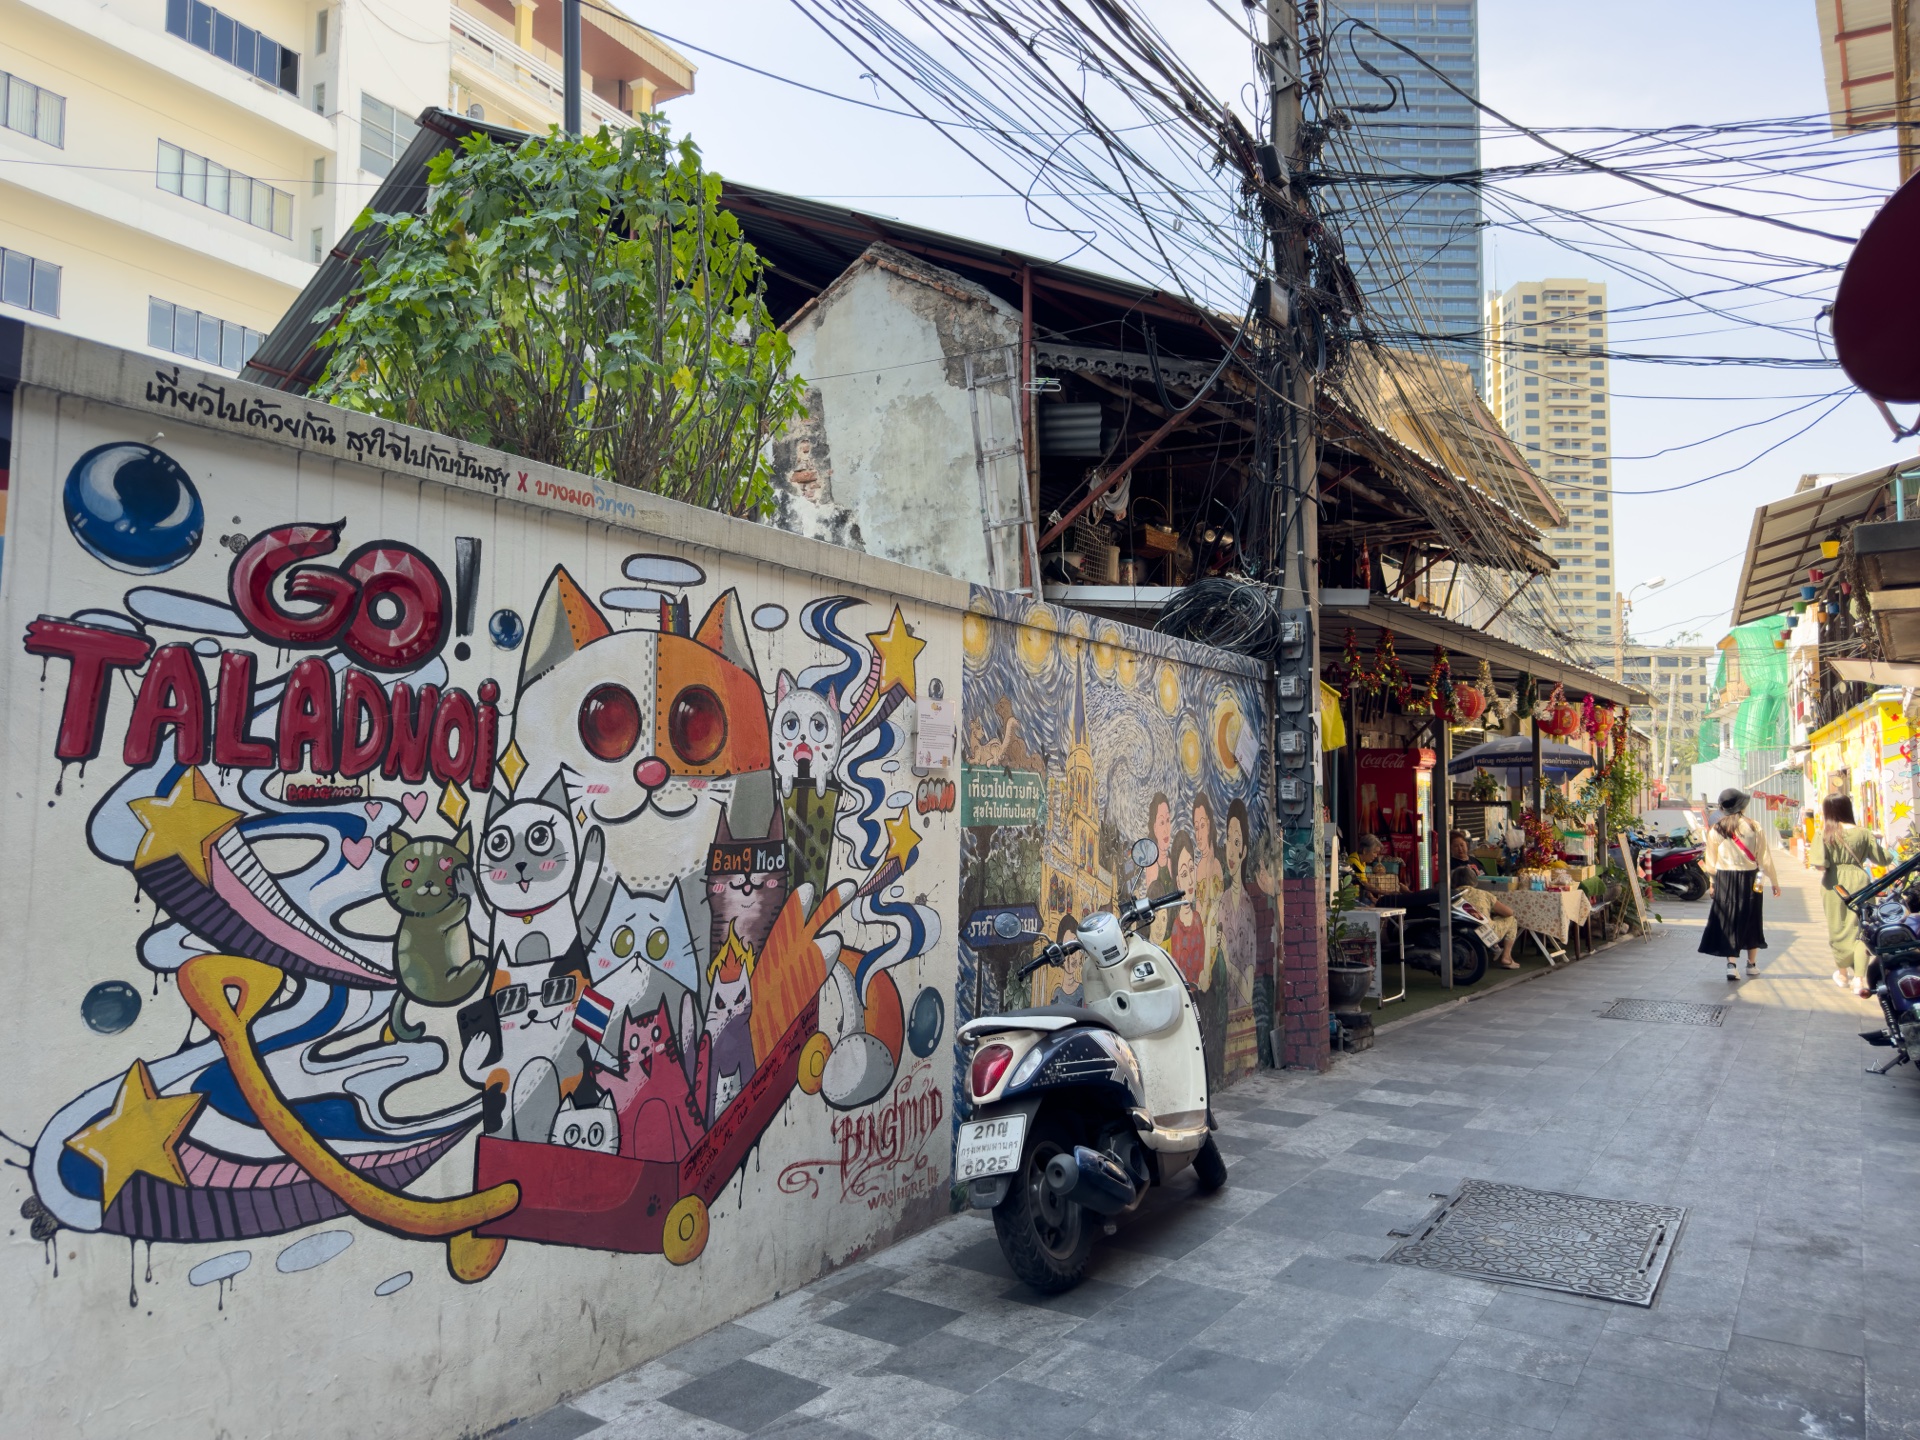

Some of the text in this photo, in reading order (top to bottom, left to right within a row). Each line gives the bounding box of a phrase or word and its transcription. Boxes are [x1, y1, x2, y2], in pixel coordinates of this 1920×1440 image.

[145, 366, 511, 494] เที่ยวไปด้วยกัน สุขใจไปกับปันสุข
[535, 480, 636, 519] บางมดวิทยา
[1361, 753, 1407, 769] Coca-Cola
[968, 772, 1040, 799] เที่ยวไปด้วยกัน
[712, 843, 786, 873] Bang Mod
[973, 1121, 1009, 1140] 2กญ
[961, 1140, 1019, 1157] กรุงเทพมหานคร
[964, 1154, 1011, 1176] 6025
[867, 1189, 894, 1211] WAS
